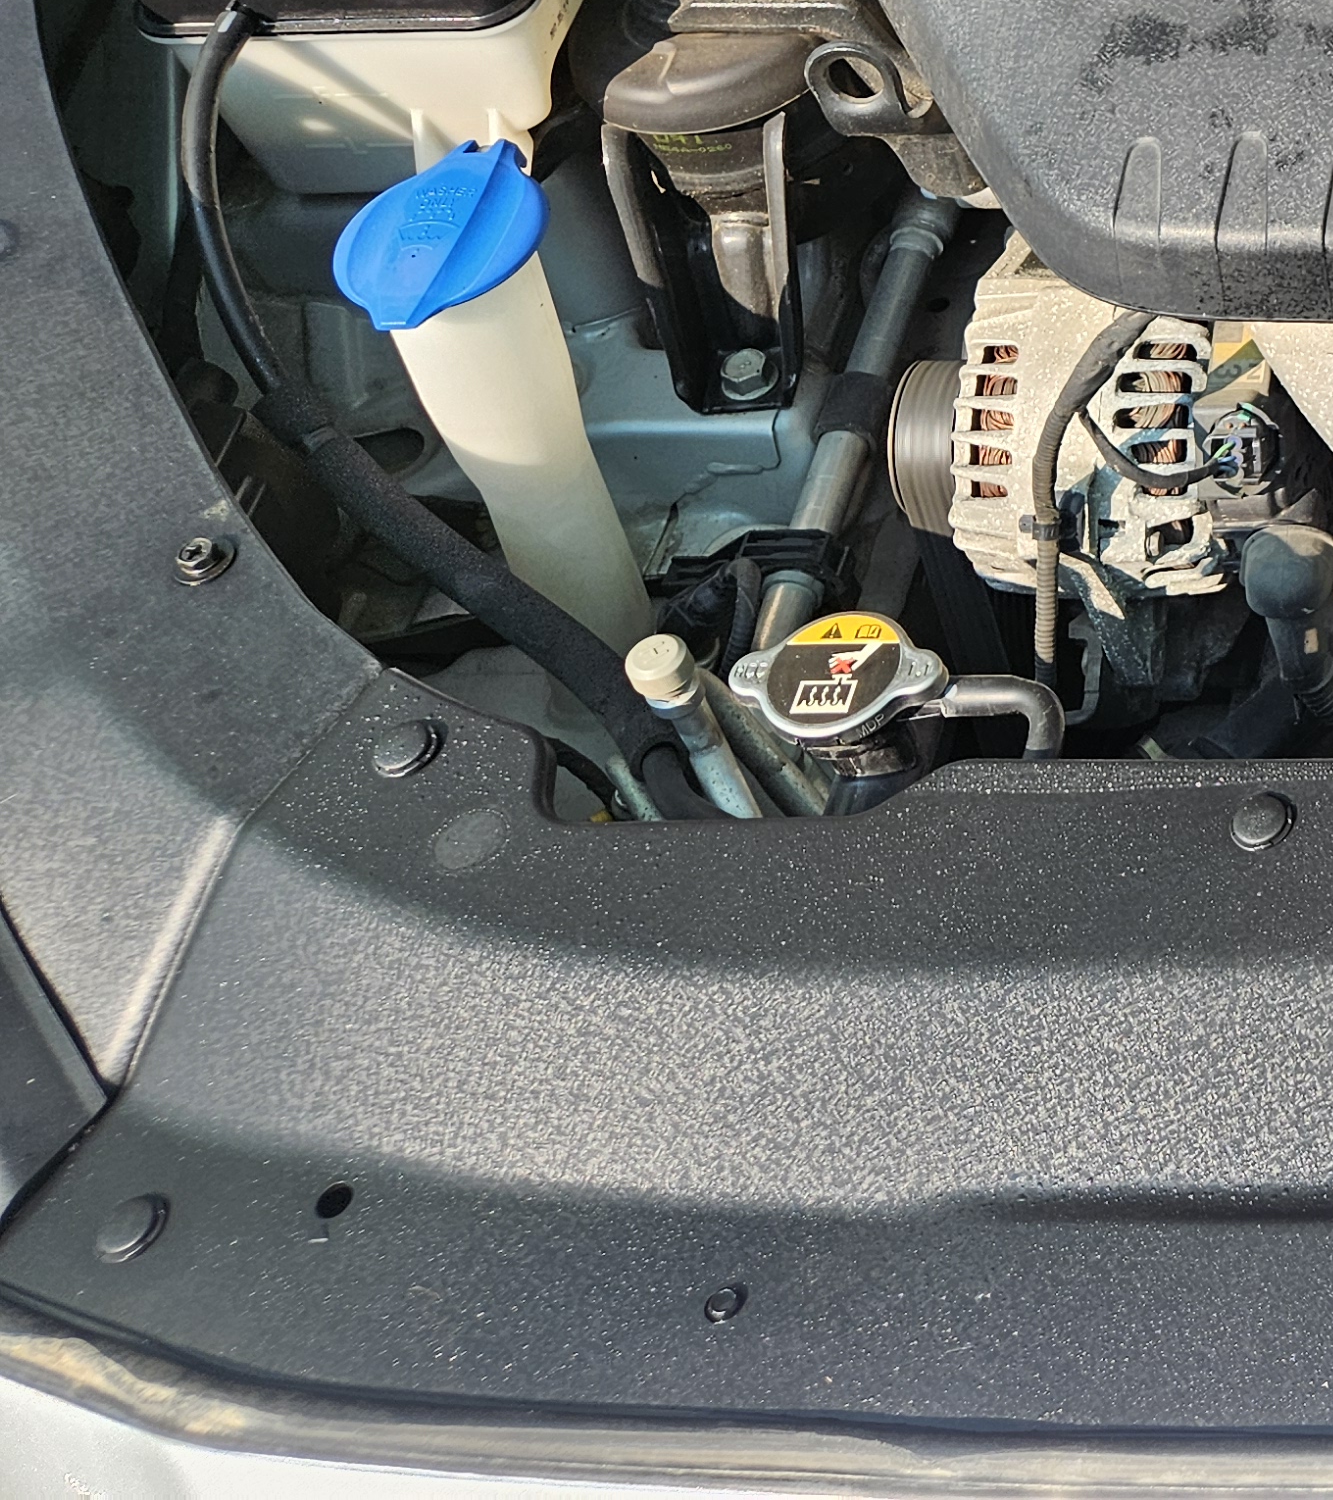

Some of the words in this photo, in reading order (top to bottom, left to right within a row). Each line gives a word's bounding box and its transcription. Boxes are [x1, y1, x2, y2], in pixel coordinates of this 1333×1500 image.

[416, 186, 478, 199] WASHER
[420, 198, 456, 209] ONLY
[855, 713, 886, 739] MDP
